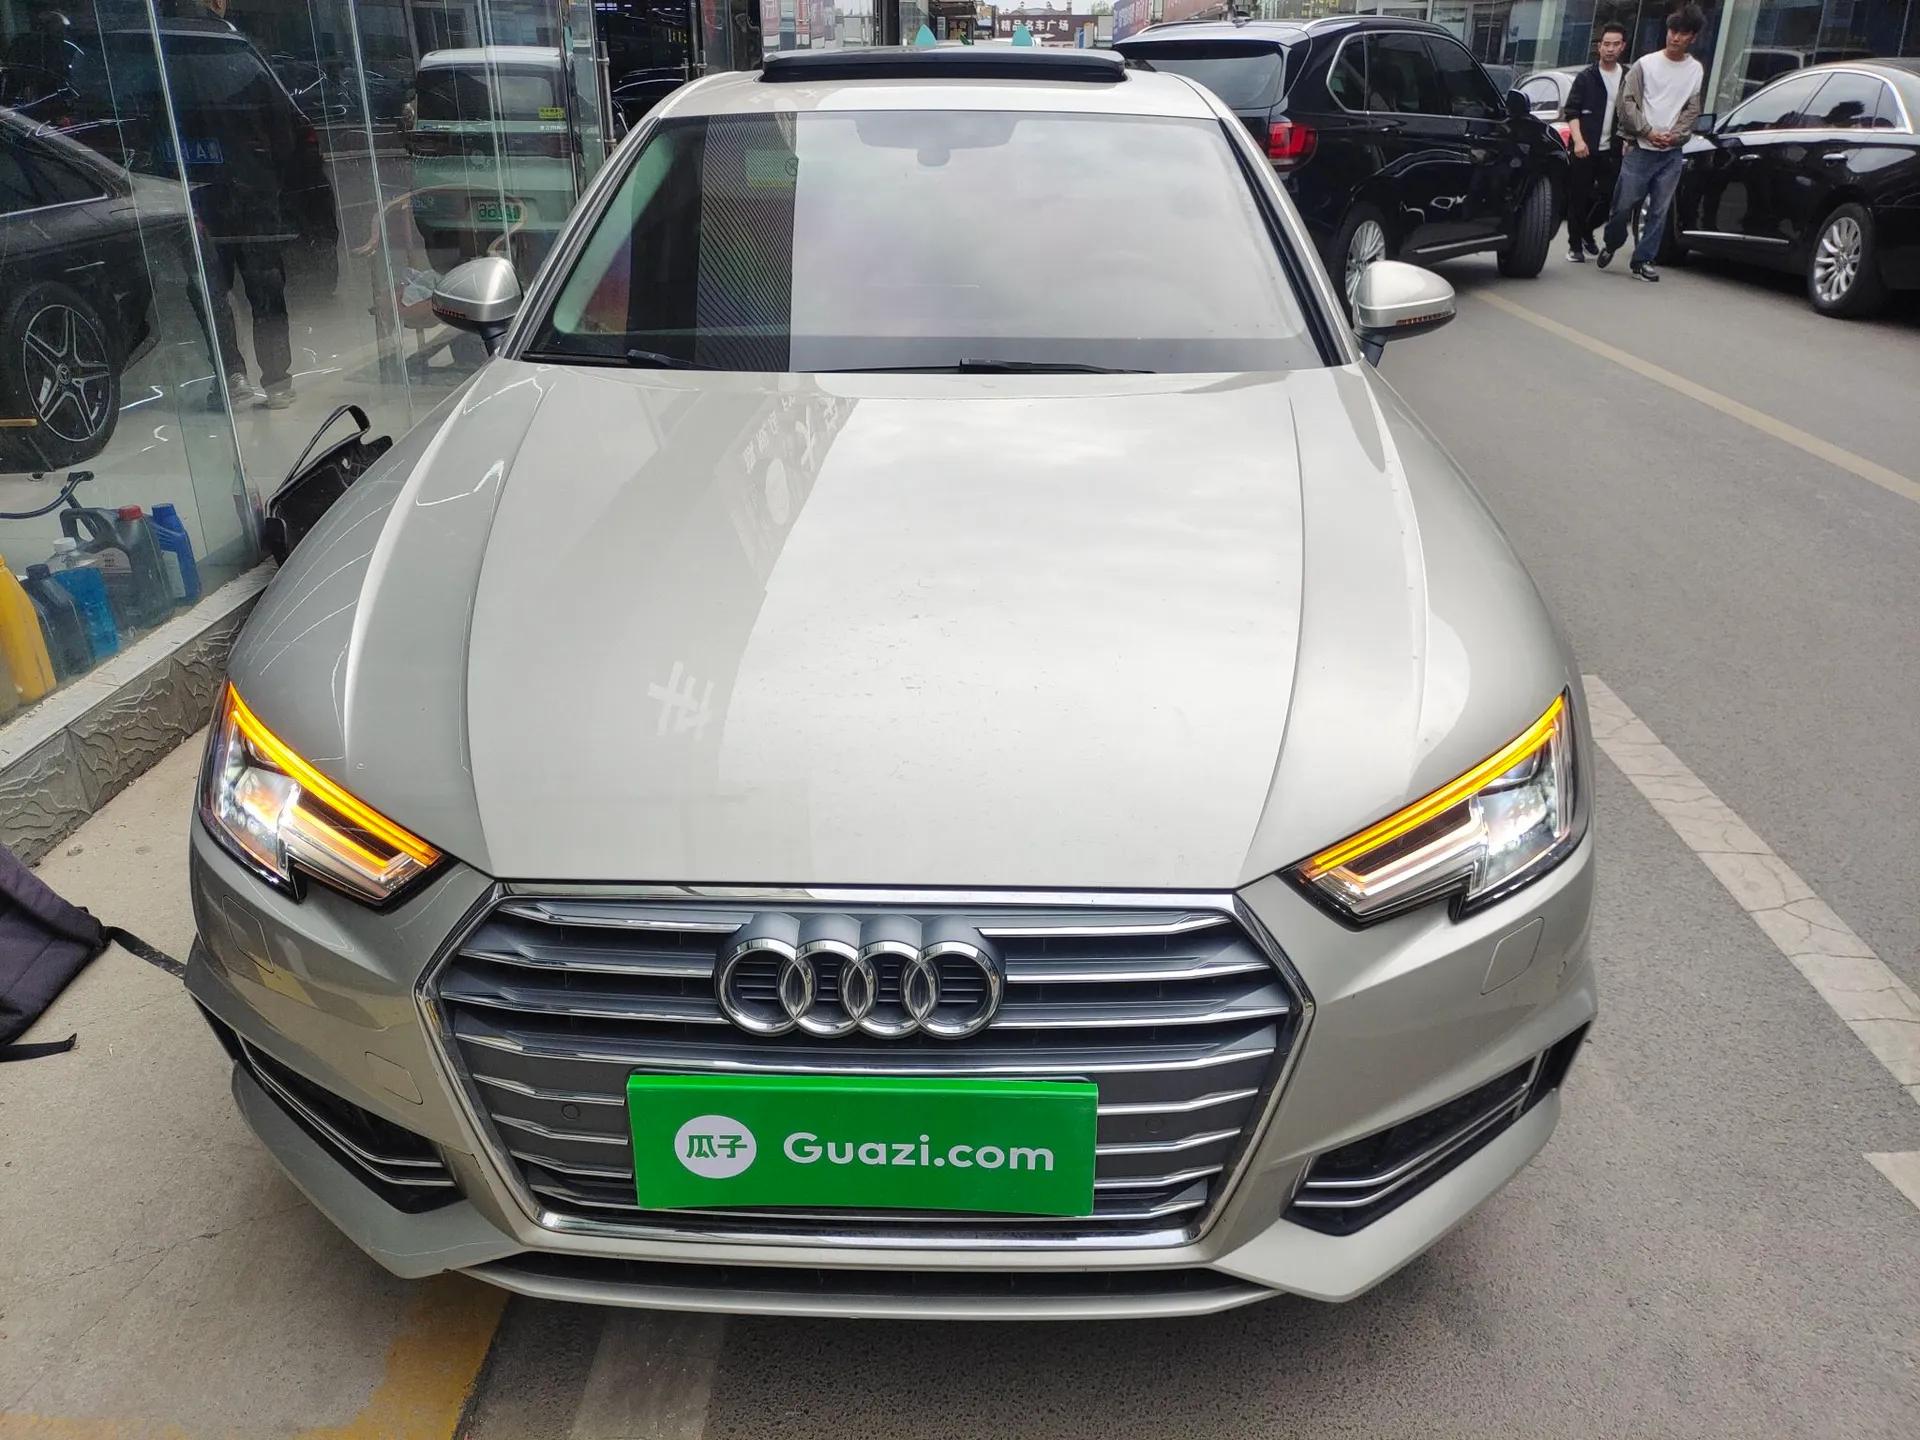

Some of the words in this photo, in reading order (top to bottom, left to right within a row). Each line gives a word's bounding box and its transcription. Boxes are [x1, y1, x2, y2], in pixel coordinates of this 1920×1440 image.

[1001, 20, 1069, 31] 精品名车广场
[687, 1134, 748, 1160] 瓜子
[783, 1132, 1055, 1171] Guazi.com
